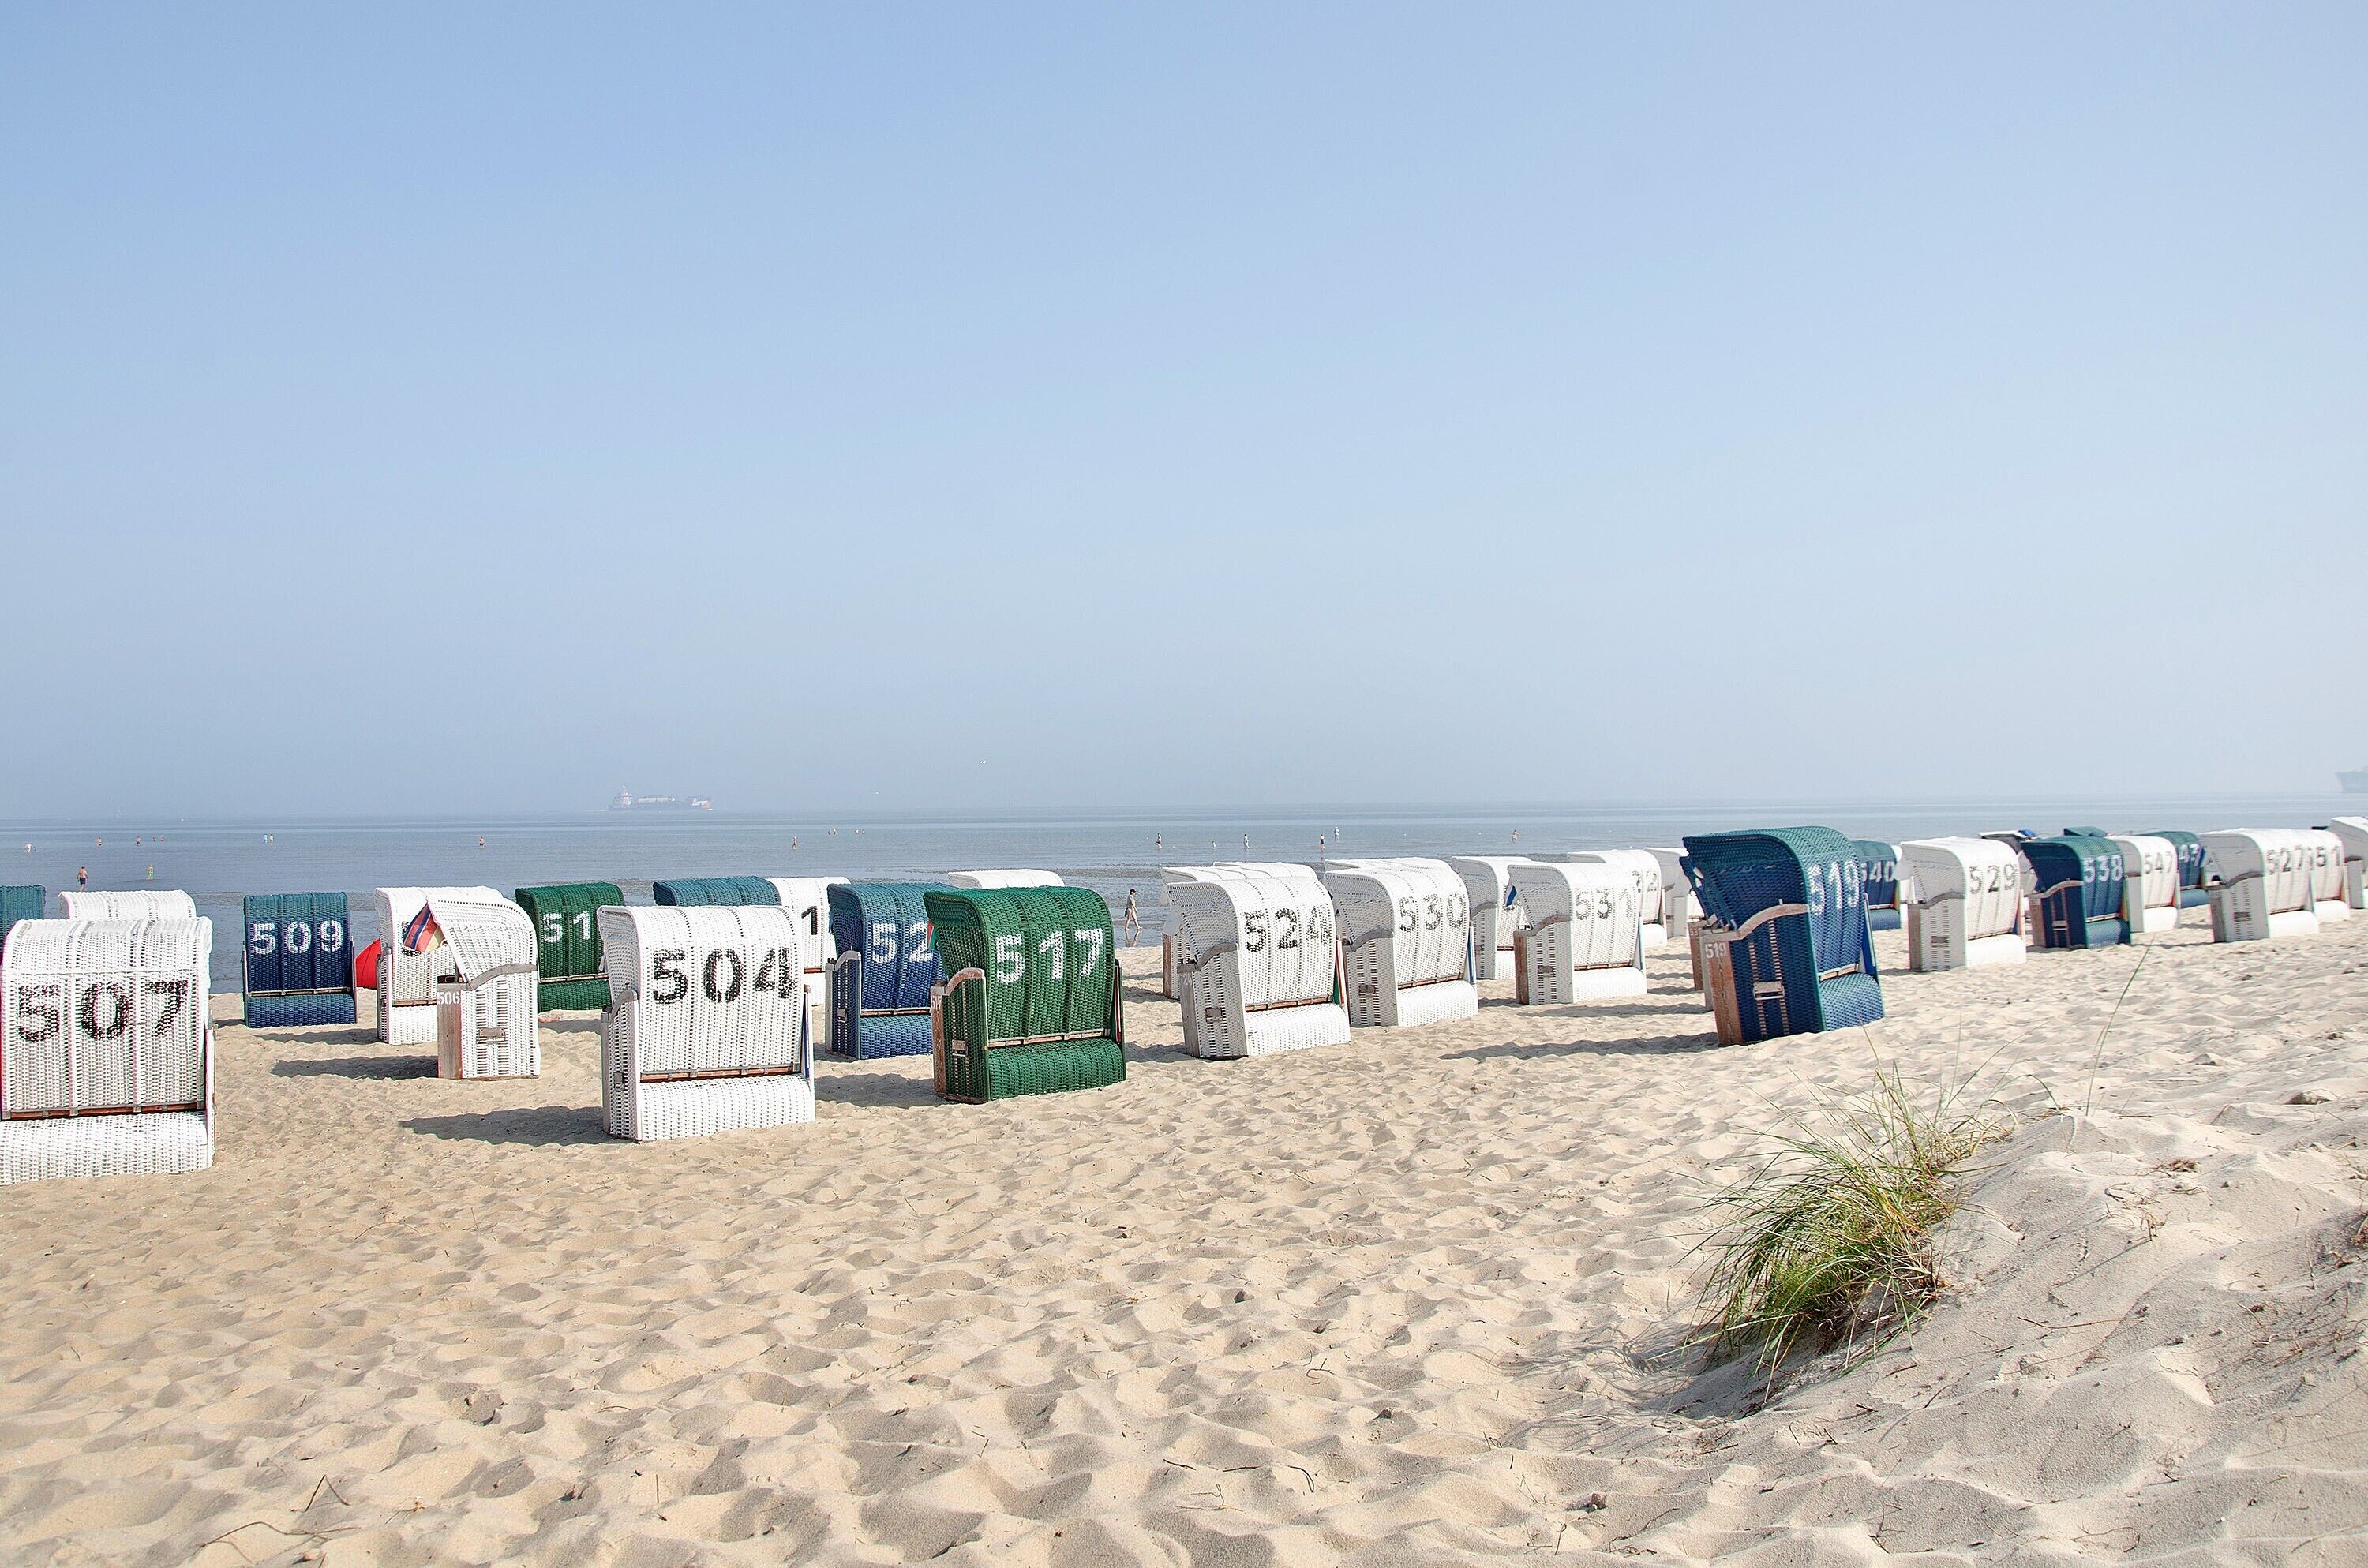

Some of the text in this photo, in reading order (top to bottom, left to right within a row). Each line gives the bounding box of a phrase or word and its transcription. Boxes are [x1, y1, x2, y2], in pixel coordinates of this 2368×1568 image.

[1808, 860, 1860, 915] 519
[1969, 863, 2016, 894] 529
[2084, 854, 2123, 883] 538
[542, 909, 592, 943] 51
[1244, 904, 1332, 952] 524
[1399, 893, 1464, 933] 530
[251, 919, 345, 955] 509
[871, 921, 933, 964] 52
[995, 927, 1104, 985] 517
[1704, 942, 1726, 959] 519
[651, 946, 796, 1005] 504
[15, 980, 189, 1042] 507
[437, 990, 461, 1005] 506
